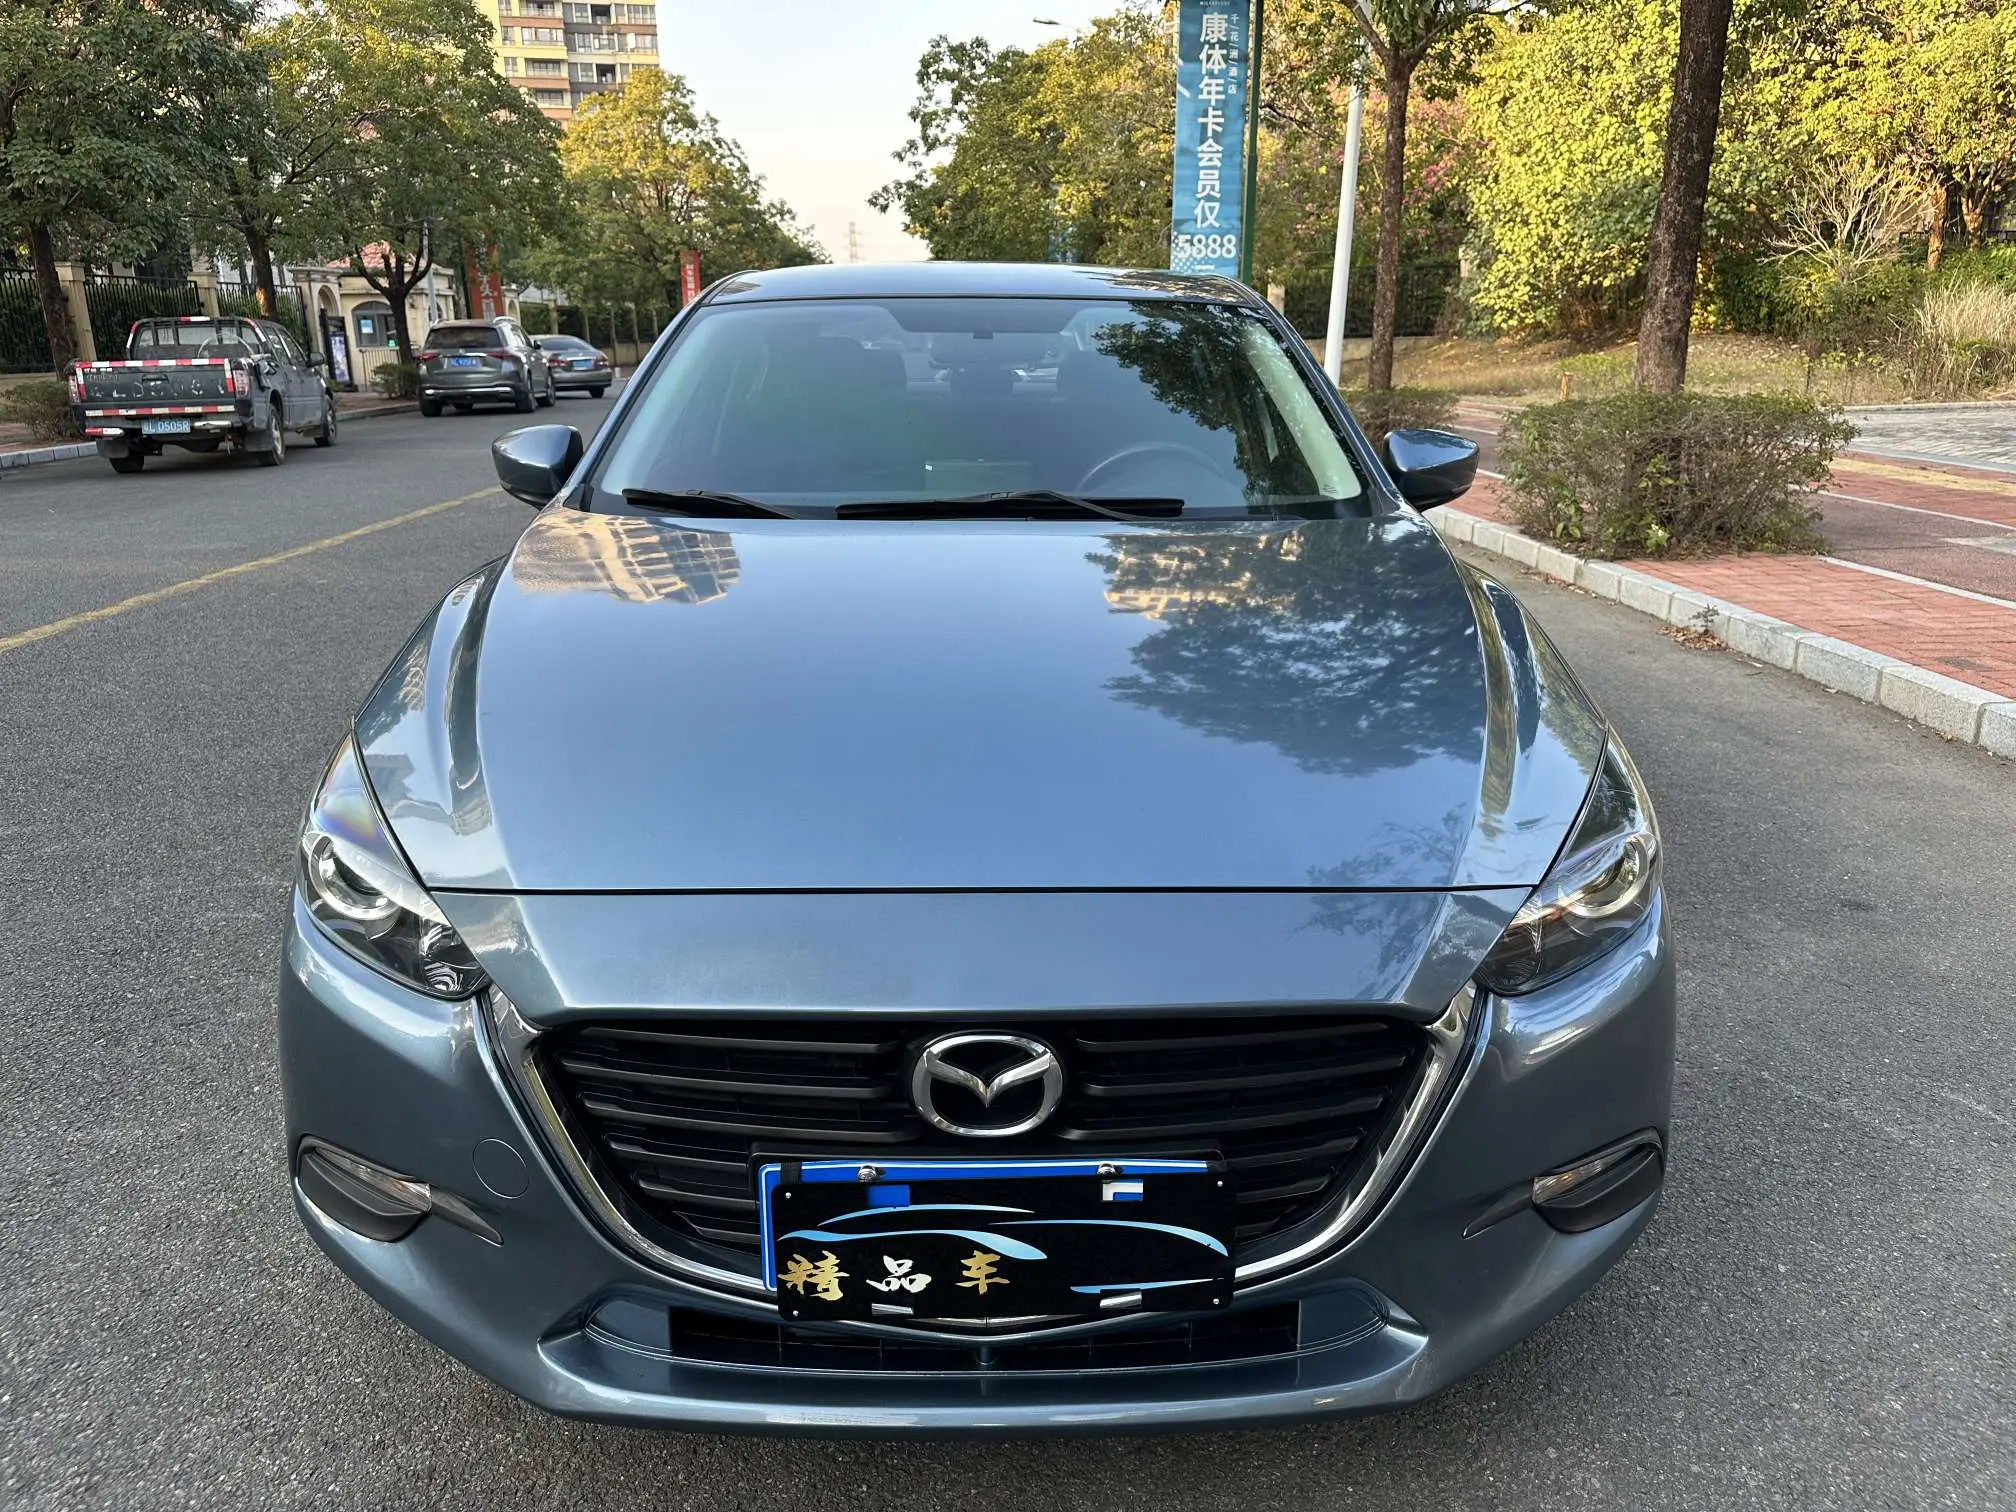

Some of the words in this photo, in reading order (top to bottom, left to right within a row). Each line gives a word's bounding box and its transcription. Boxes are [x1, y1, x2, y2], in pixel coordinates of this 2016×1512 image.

[1193, 11, 1229, 228] 康体年卡会员仅
[1176, 233, 1237, 259] 5888
[777, 1250, 1010, 1300] 精品车
